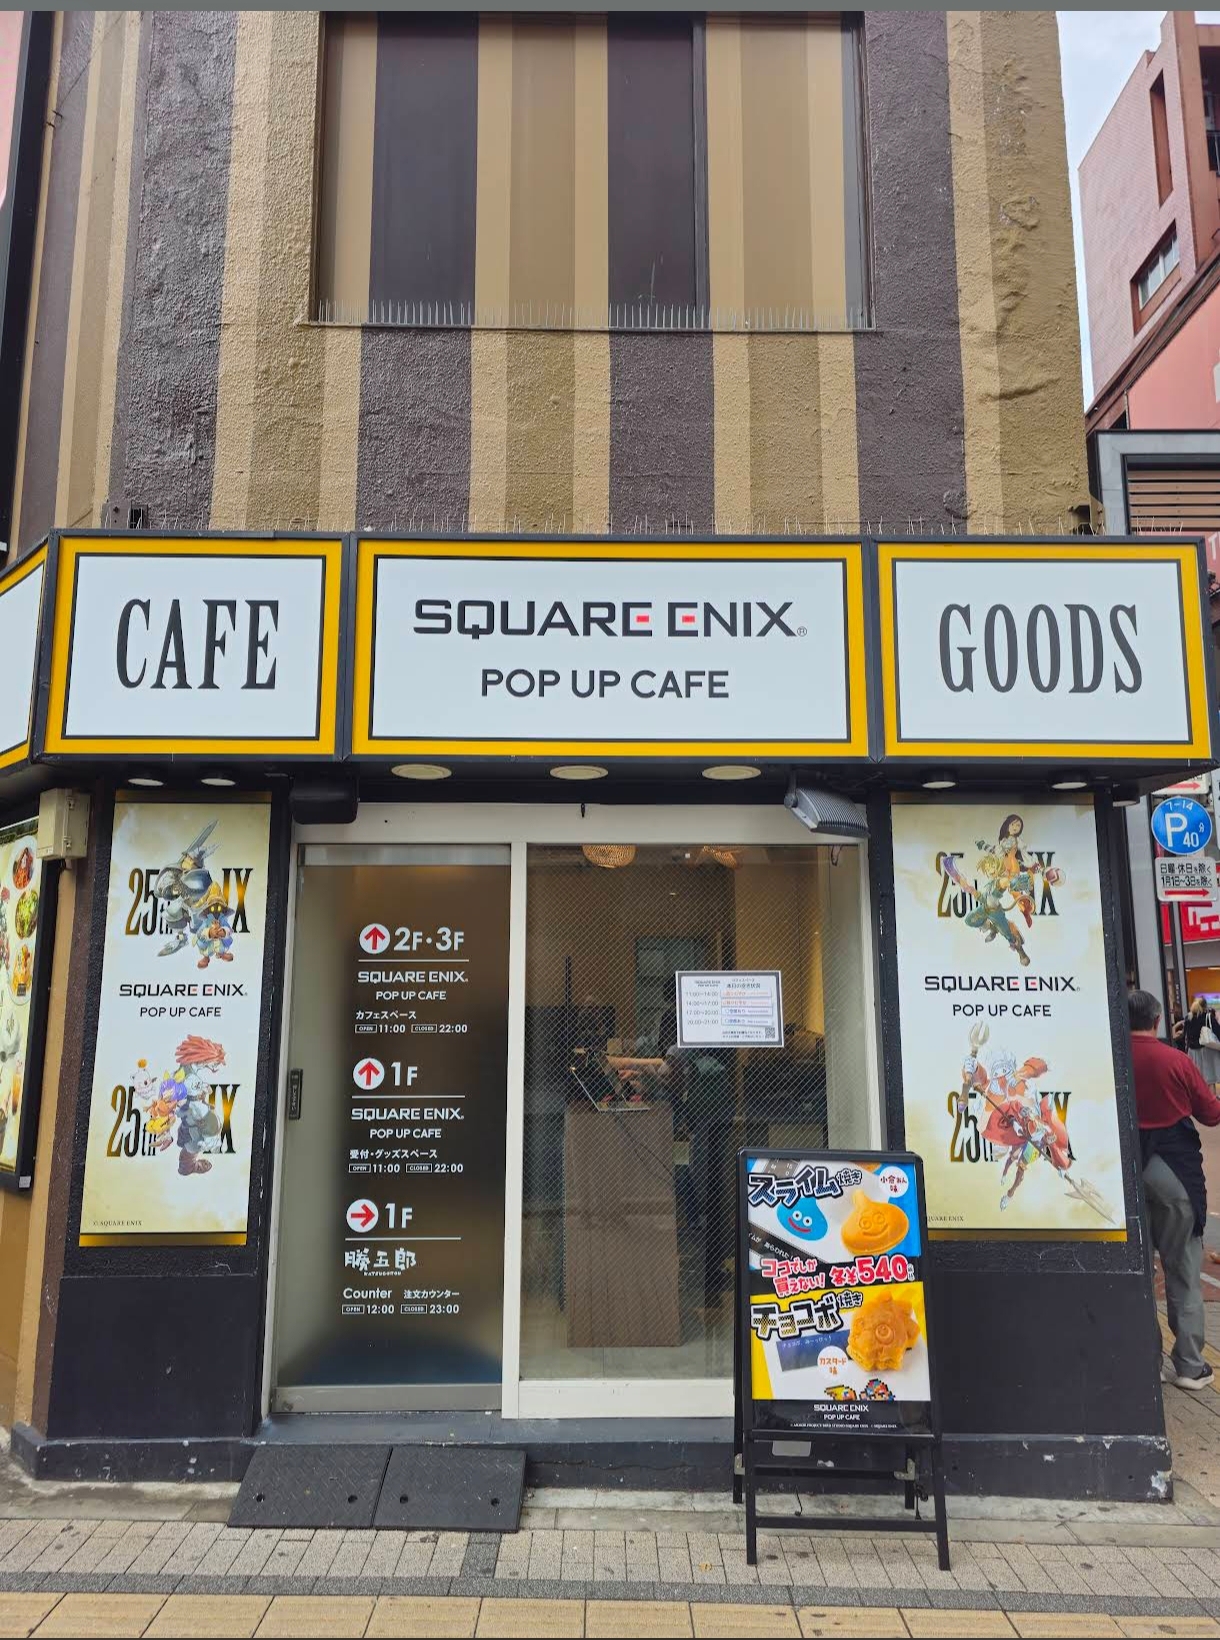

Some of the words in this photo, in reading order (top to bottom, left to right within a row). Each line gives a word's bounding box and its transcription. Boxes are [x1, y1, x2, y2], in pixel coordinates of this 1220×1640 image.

[413, 599, 652, 639] SQUARE
[117, 598, 279, 689] CAFE
[939, 603, 1142, 693] GOODS
[481, 669, 560, 697] POP
[571, 670, 620, 698] UP
[631, 670, 729, 698] CAFE
[1165, 813, 1187, 847] P
[1183, 832, 1199, 848] 40
[358, 971, 425, 984] SQUARE
[925, 976, 1019, 992] SQUARE
[119, 984, 198, 998] SQUARE
[376, 991, 399, 1000] POP
[401, 991, 415, 1000] UP
[418, 991, 446, 1000] CAFE
[140, 1007, 166, 1017] POP
[169, 1007, 186, 1017] UP
[189, 1007, 221, 1017] CAFE
[356, 1010, 417, 1020] カフェスペース
[953, 1004, 984, 1016] POP
[988, 1004, 1007, 1016] UP
[1012, 1004, 1051, 1017] CAFE
[379, 1025, 406, 1033] 11:00
[439, 1025, 468, 1033] 22:00
[391, 1061, 418, 1087] 1F
[351, 1108, 420, 1121] SQUARE
[1039, 1092, 1077, 1161] X
[370, 1129, 393, 1138] POP
[396, 1129, 410, 1138] UP
[413, 1129, 441, 1138] CAFE
[373, 1164, 400, 1173] 11:00
[434, 1164, 464, 1173] 22:00
[385, 1203, 413, 1229] 1F
[345, 1247, 417, 1271] 勝五郎
[762, 1258, 818, 1278] ココでしか
[343, 1288, 392, 1299] Counter
[404, 1289, 460, 1299] 注文カウンター
[366, 1304, 394, 1314] 12:00
[429, 1304, 459, 1314] 23:00
[820, 1357, 847, 1366] カスタード
[814, 1404, 848, 1412] SQUARE
[850, 1404, 869, 1412] ENIX
